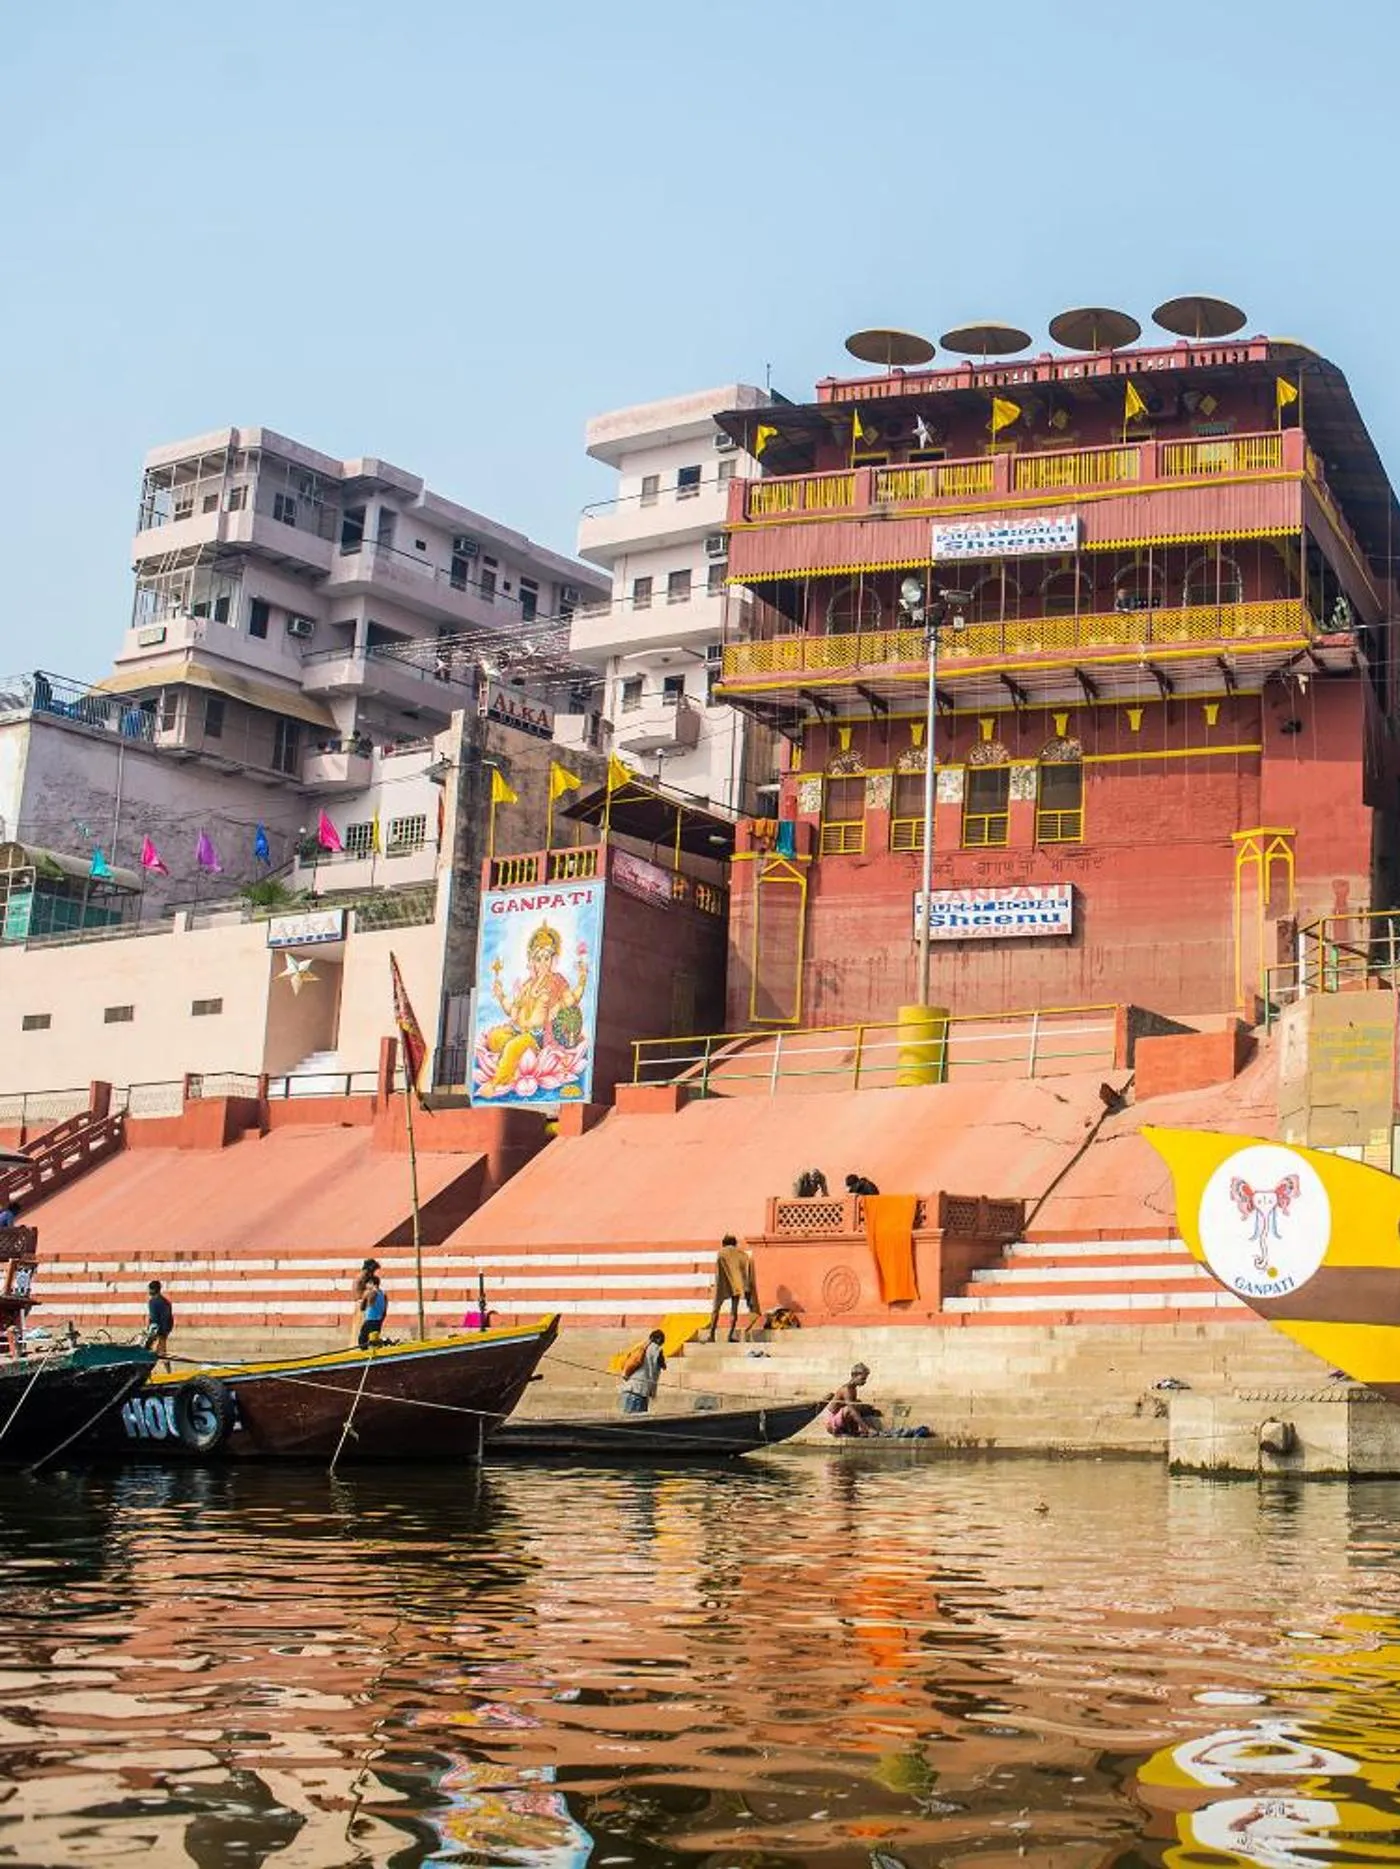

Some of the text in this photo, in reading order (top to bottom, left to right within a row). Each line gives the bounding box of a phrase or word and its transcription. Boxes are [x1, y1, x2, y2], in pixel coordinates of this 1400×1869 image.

[493, 692, 550, 728] ALKA
[491, 891, 593, 914] GANPATI
[929, 912, 1061, 927] Sheenu
[1234, 1275, 1296, 1295] GANPATI
